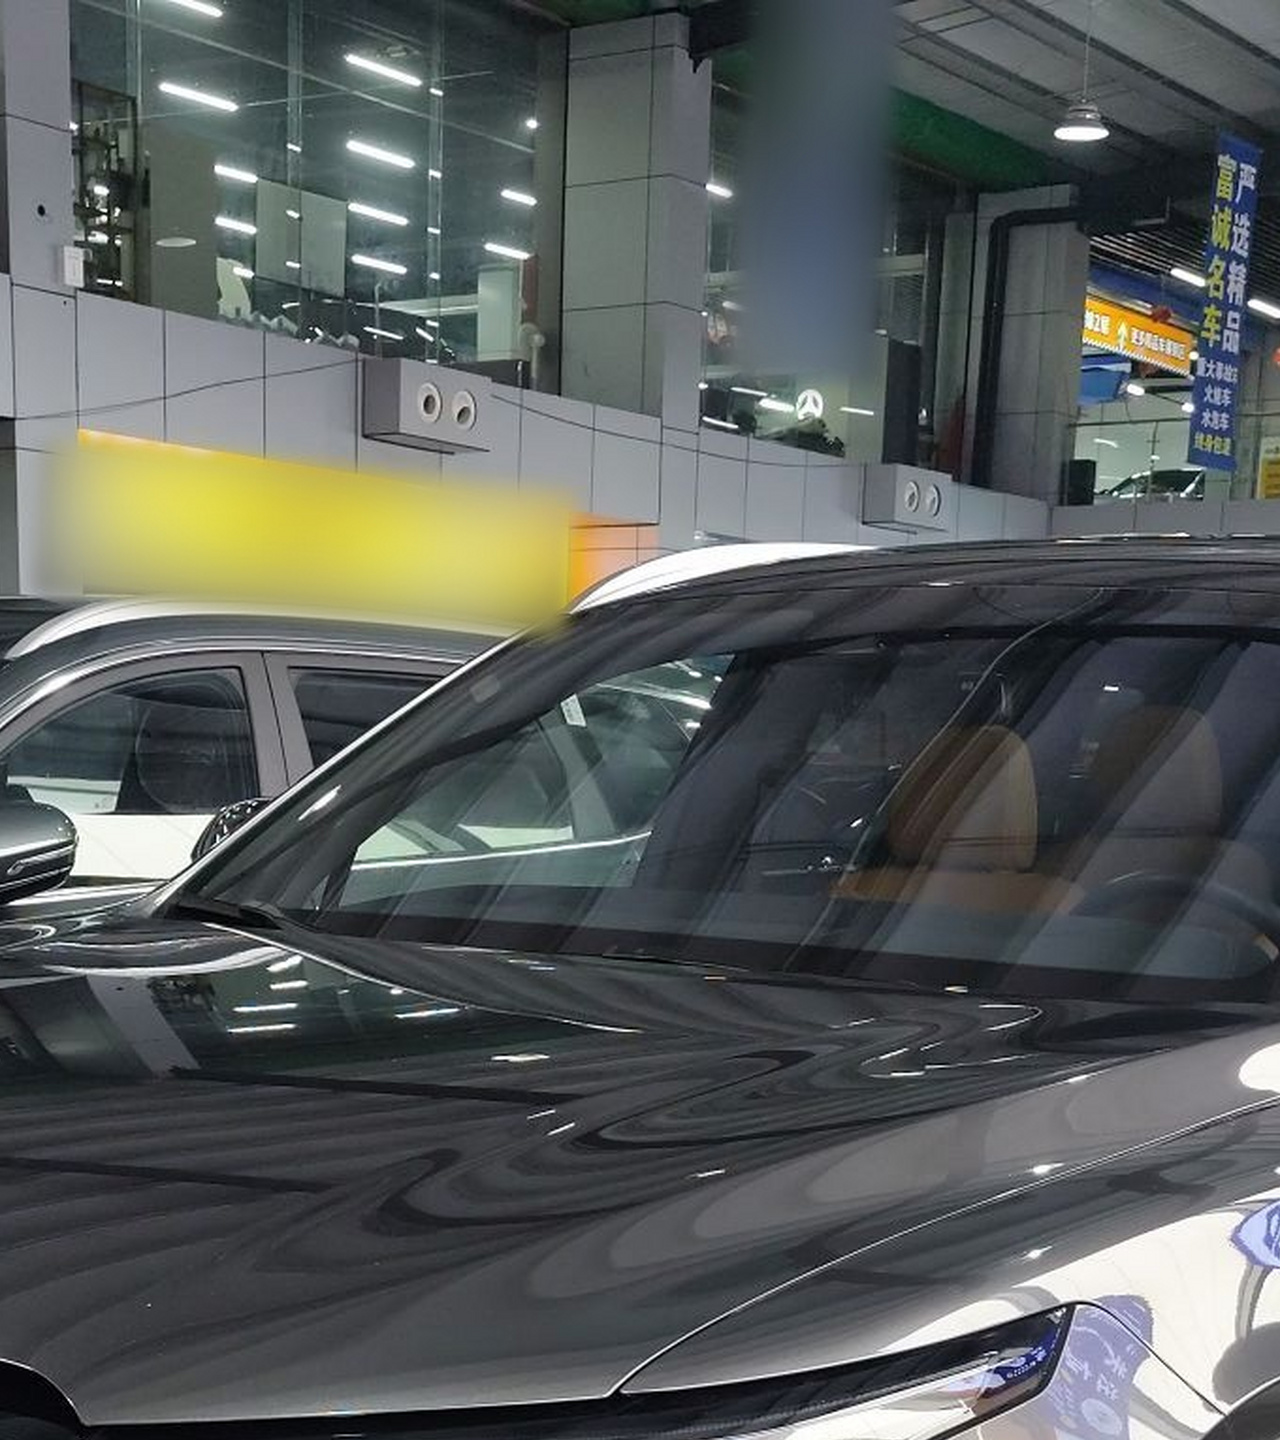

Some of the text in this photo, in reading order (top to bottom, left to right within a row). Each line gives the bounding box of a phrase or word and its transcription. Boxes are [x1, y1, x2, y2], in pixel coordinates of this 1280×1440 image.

[1201, 153, 1238, 347] 富诚名车
[1222, 161, 1258, 355] 严选精品
